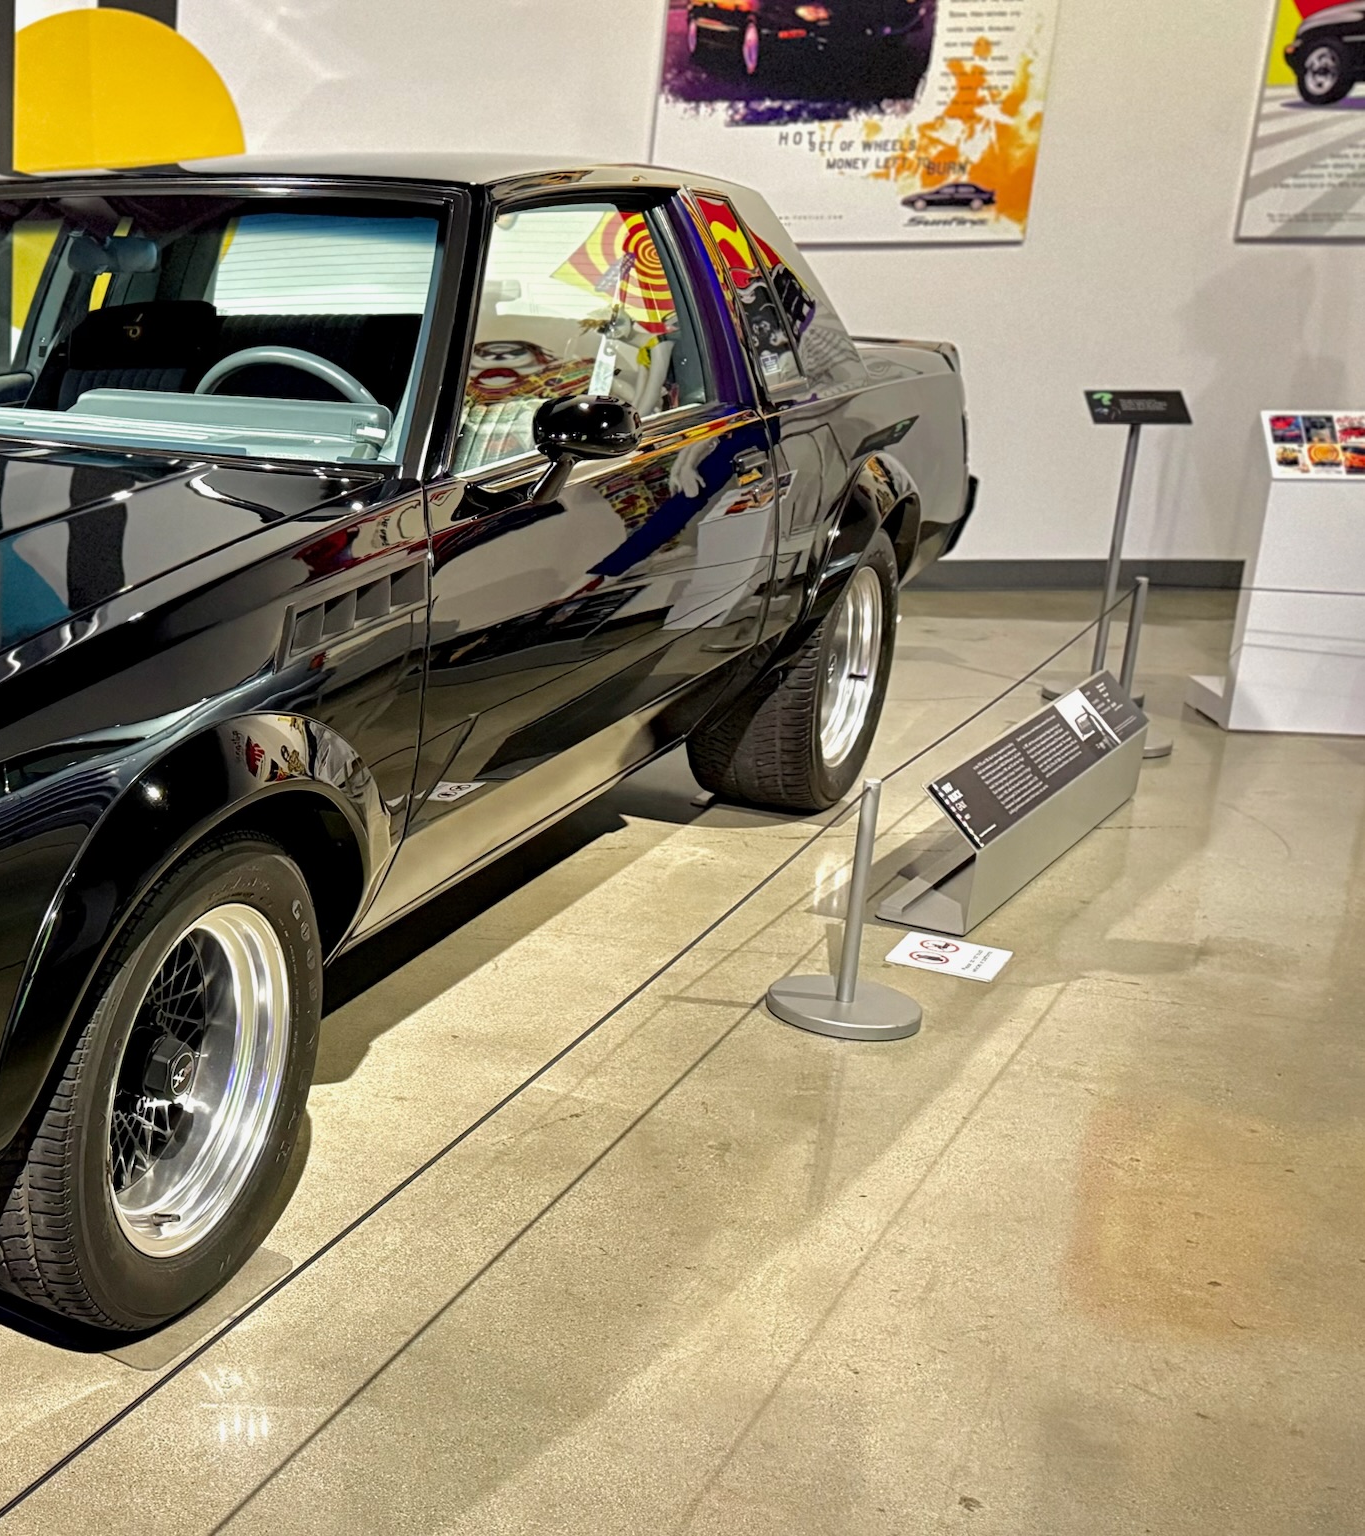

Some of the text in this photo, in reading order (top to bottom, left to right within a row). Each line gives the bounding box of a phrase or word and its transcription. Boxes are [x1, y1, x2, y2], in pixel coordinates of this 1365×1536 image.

[778, 131, 816, 146] HOT
[808, 140, 834, 152] SET
[839, 140, 855, 151] OF
[826, 156, 930, 170] MONEY LEFT TO
